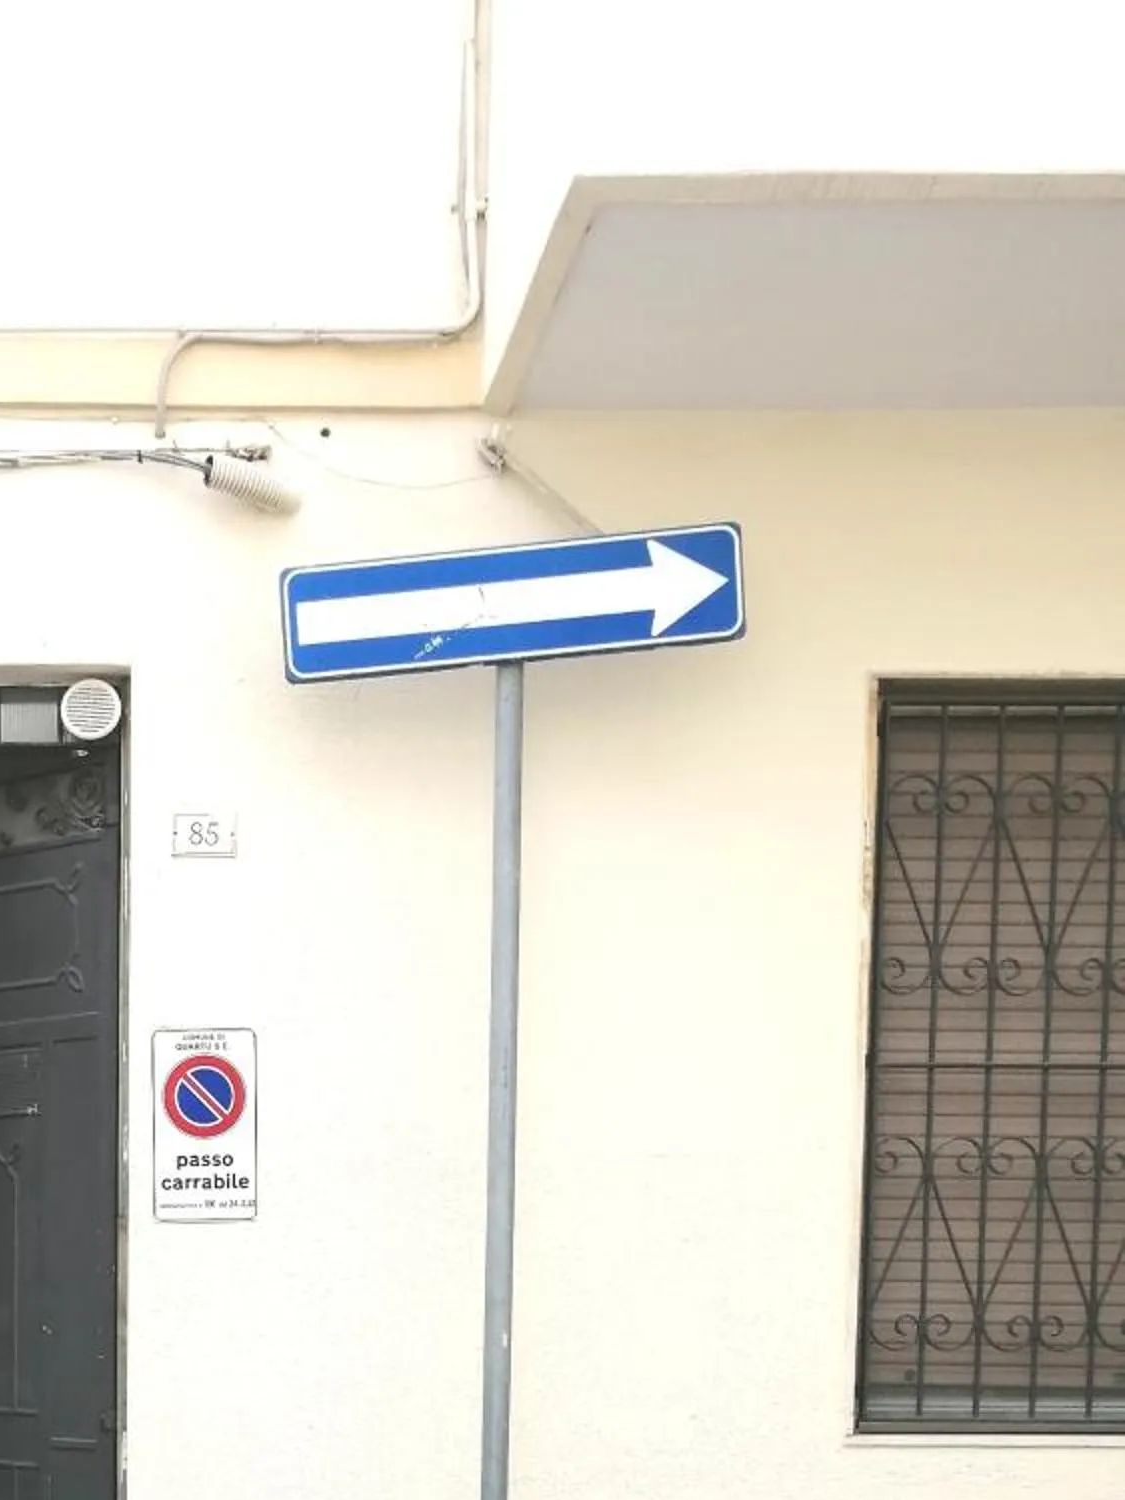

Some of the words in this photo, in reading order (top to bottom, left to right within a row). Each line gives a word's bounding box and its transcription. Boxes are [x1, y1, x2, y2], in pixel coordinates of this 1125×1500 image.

[189, 821, 219, 847] 85
[176, 1153, 234, 1171] passo
[161, 1172, 250, 1190] carrabile
